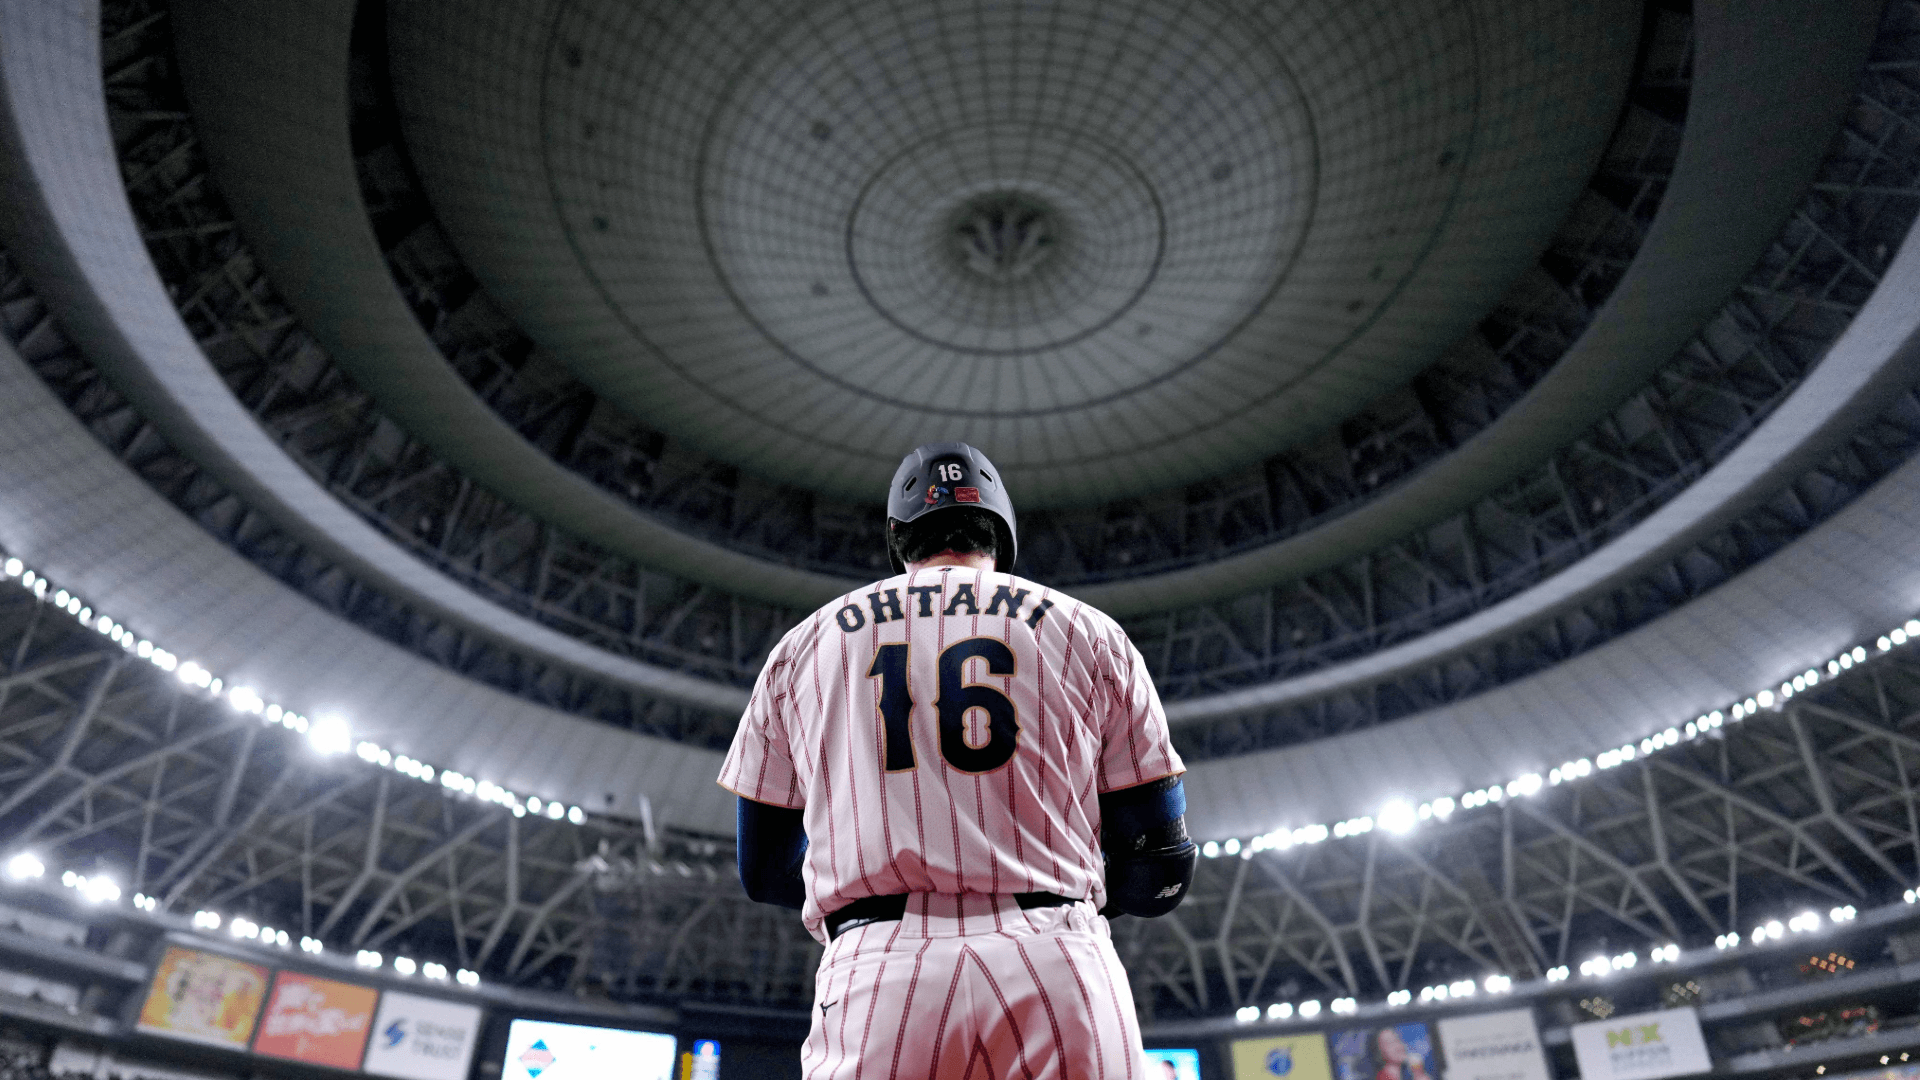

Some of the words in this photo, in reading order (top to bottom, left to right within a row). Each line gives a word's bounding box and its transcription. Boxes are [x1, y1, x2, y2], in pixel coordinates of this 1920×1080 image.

[938, 463, 963, 482] 16
[835, 583, 1054, 633] OHTANI
[865, 635, 1024, 775] 16
